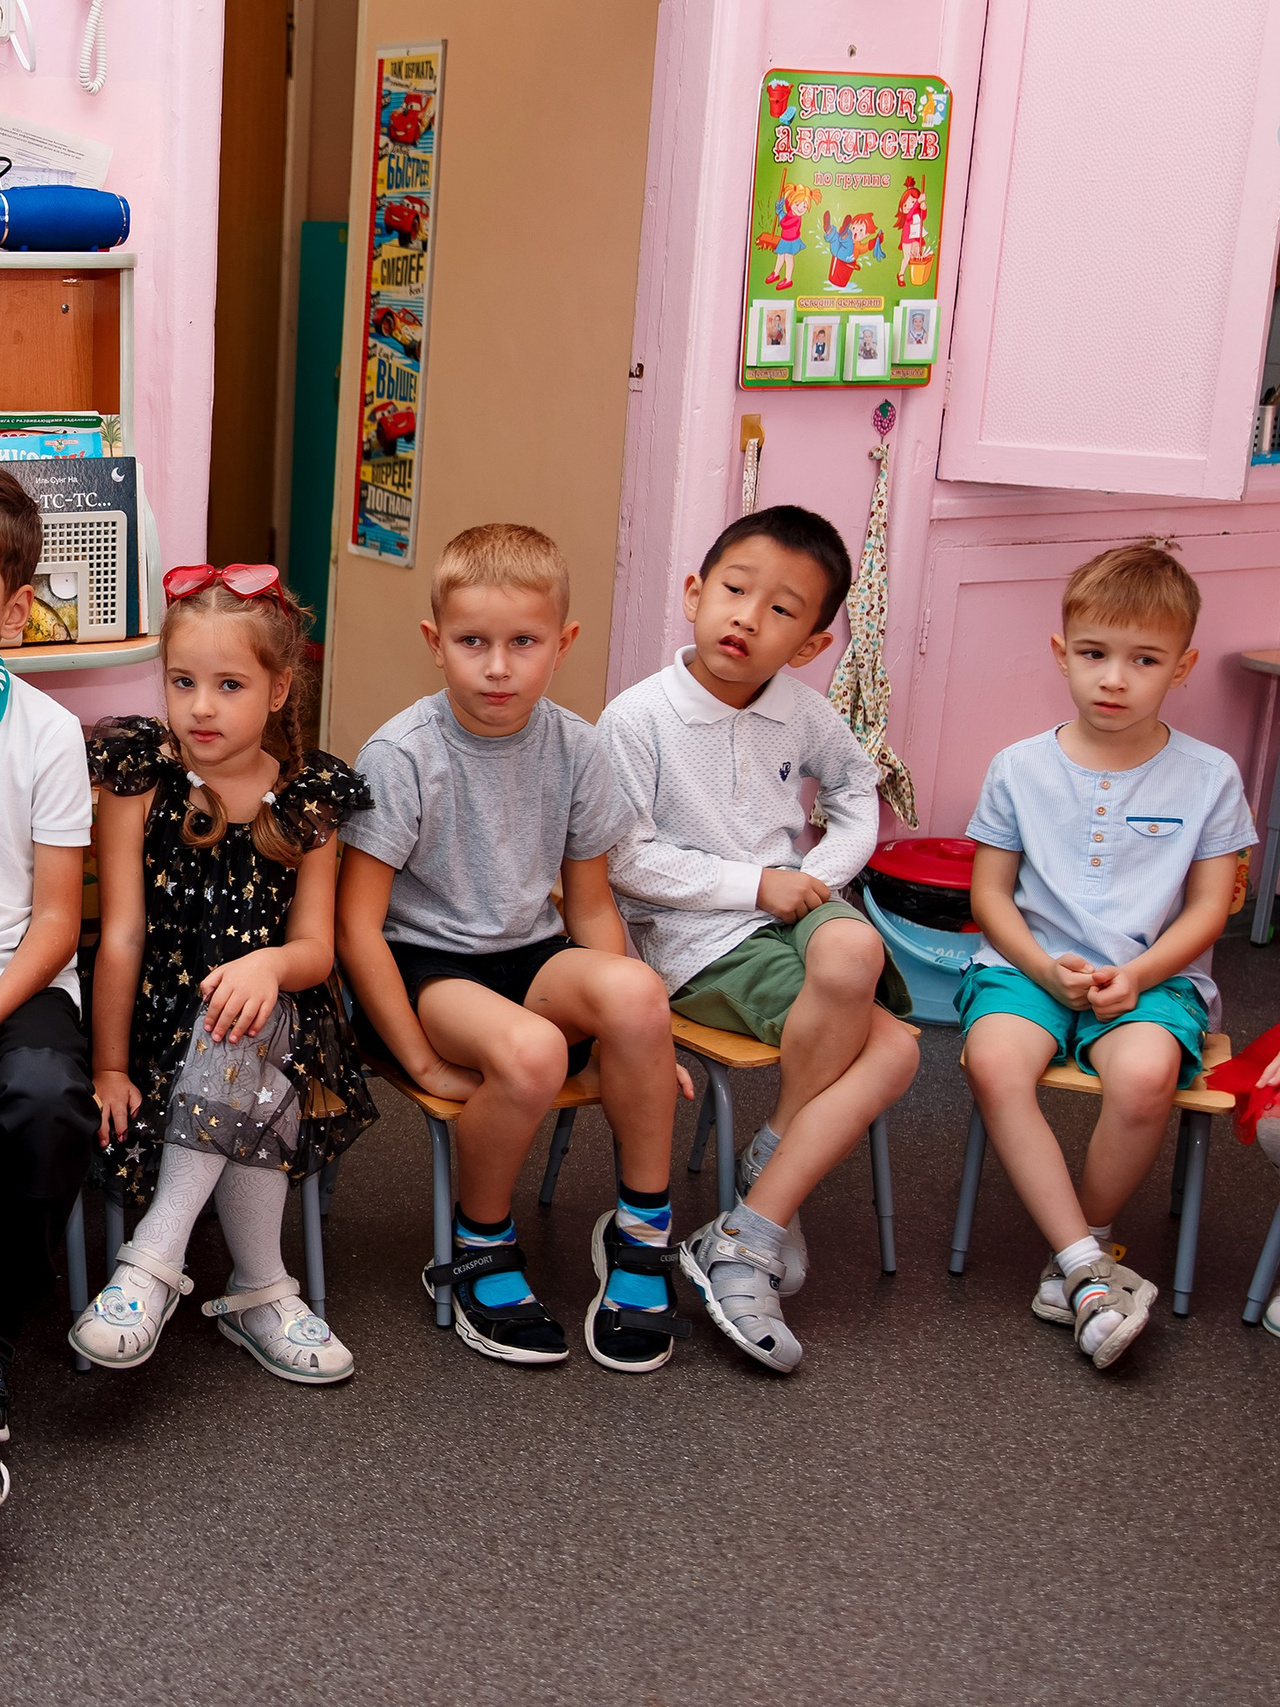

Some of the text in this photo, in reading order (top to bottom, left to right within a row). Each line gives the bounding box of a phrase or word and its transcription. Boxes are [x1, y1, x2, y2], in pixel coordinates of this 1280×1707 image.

[799, 84, 918, 122] УГОЛОК
[773, 126, 941, 163] ДЕЖУРСТВ
[387, 153, 429, 189] БЫСТРЕЕ!
[814, 172, 891, 189] по группе
[376, 359, 417, 402] ВЫШЕ!
